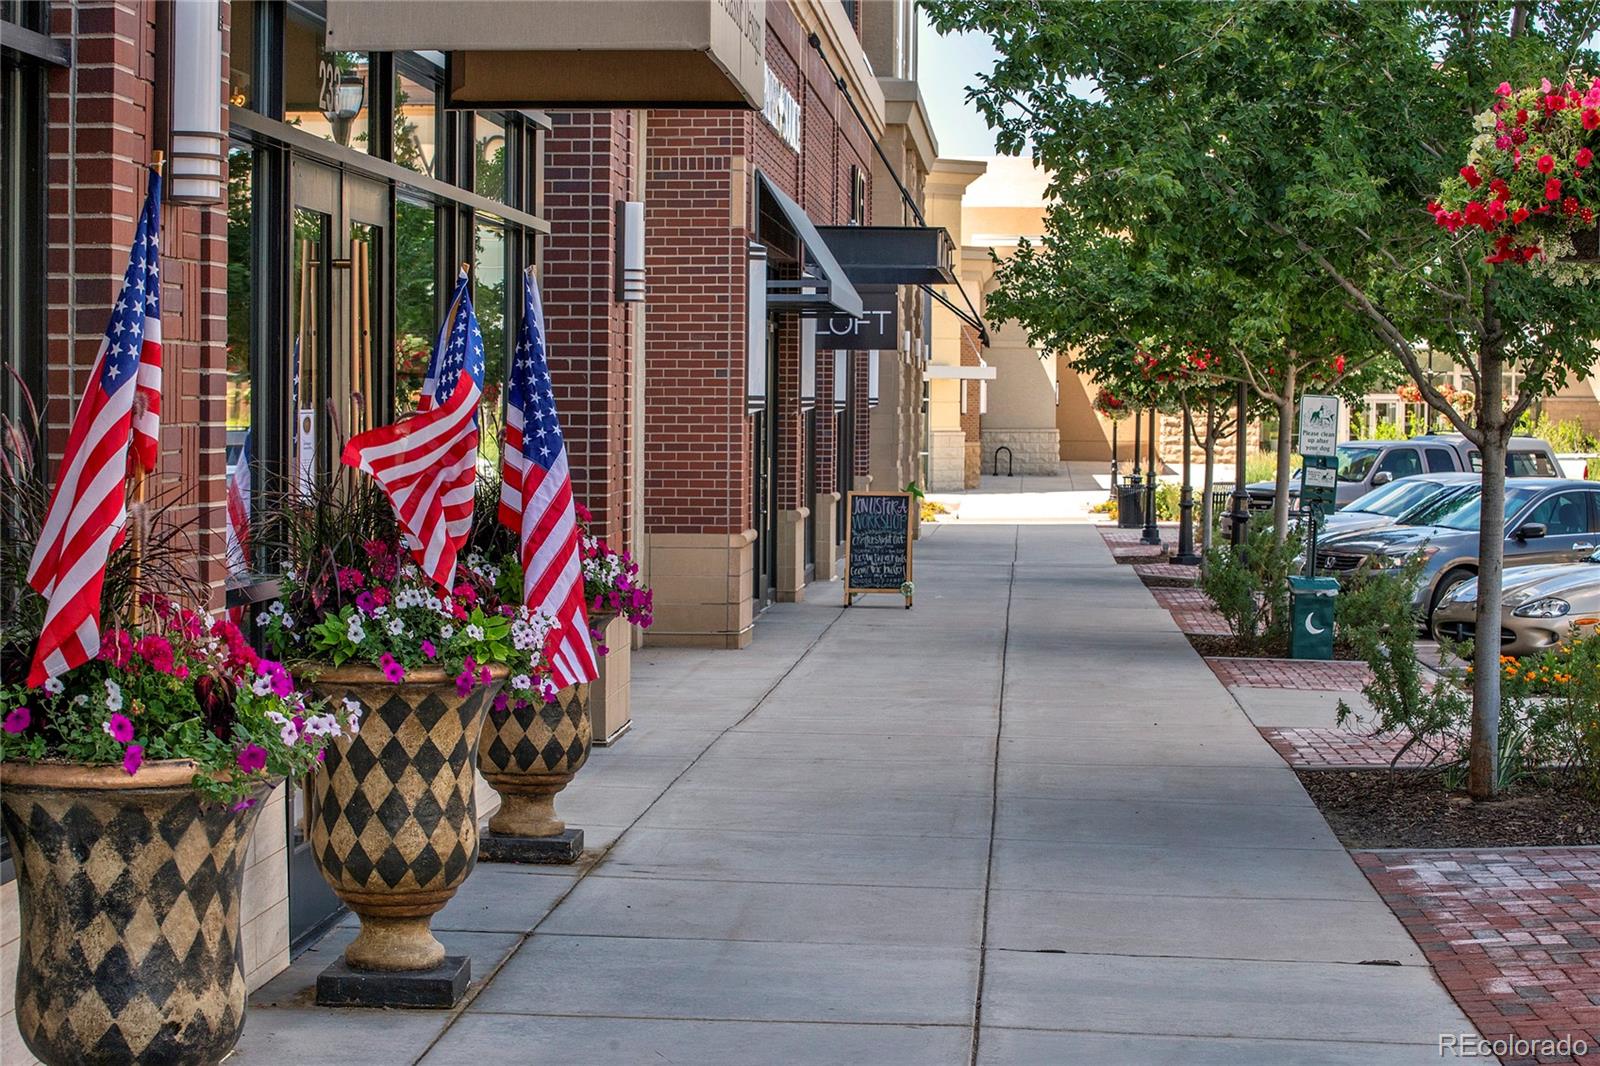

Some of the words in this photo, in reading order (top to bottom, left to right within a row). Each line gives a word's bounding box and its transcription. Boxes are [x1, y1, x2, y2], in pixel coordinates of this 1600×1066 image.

[319, 60, 341, 114] 233
[1319, 445, 1330, 453] dog
[852, 514, 907, 529] WORKSHOP
